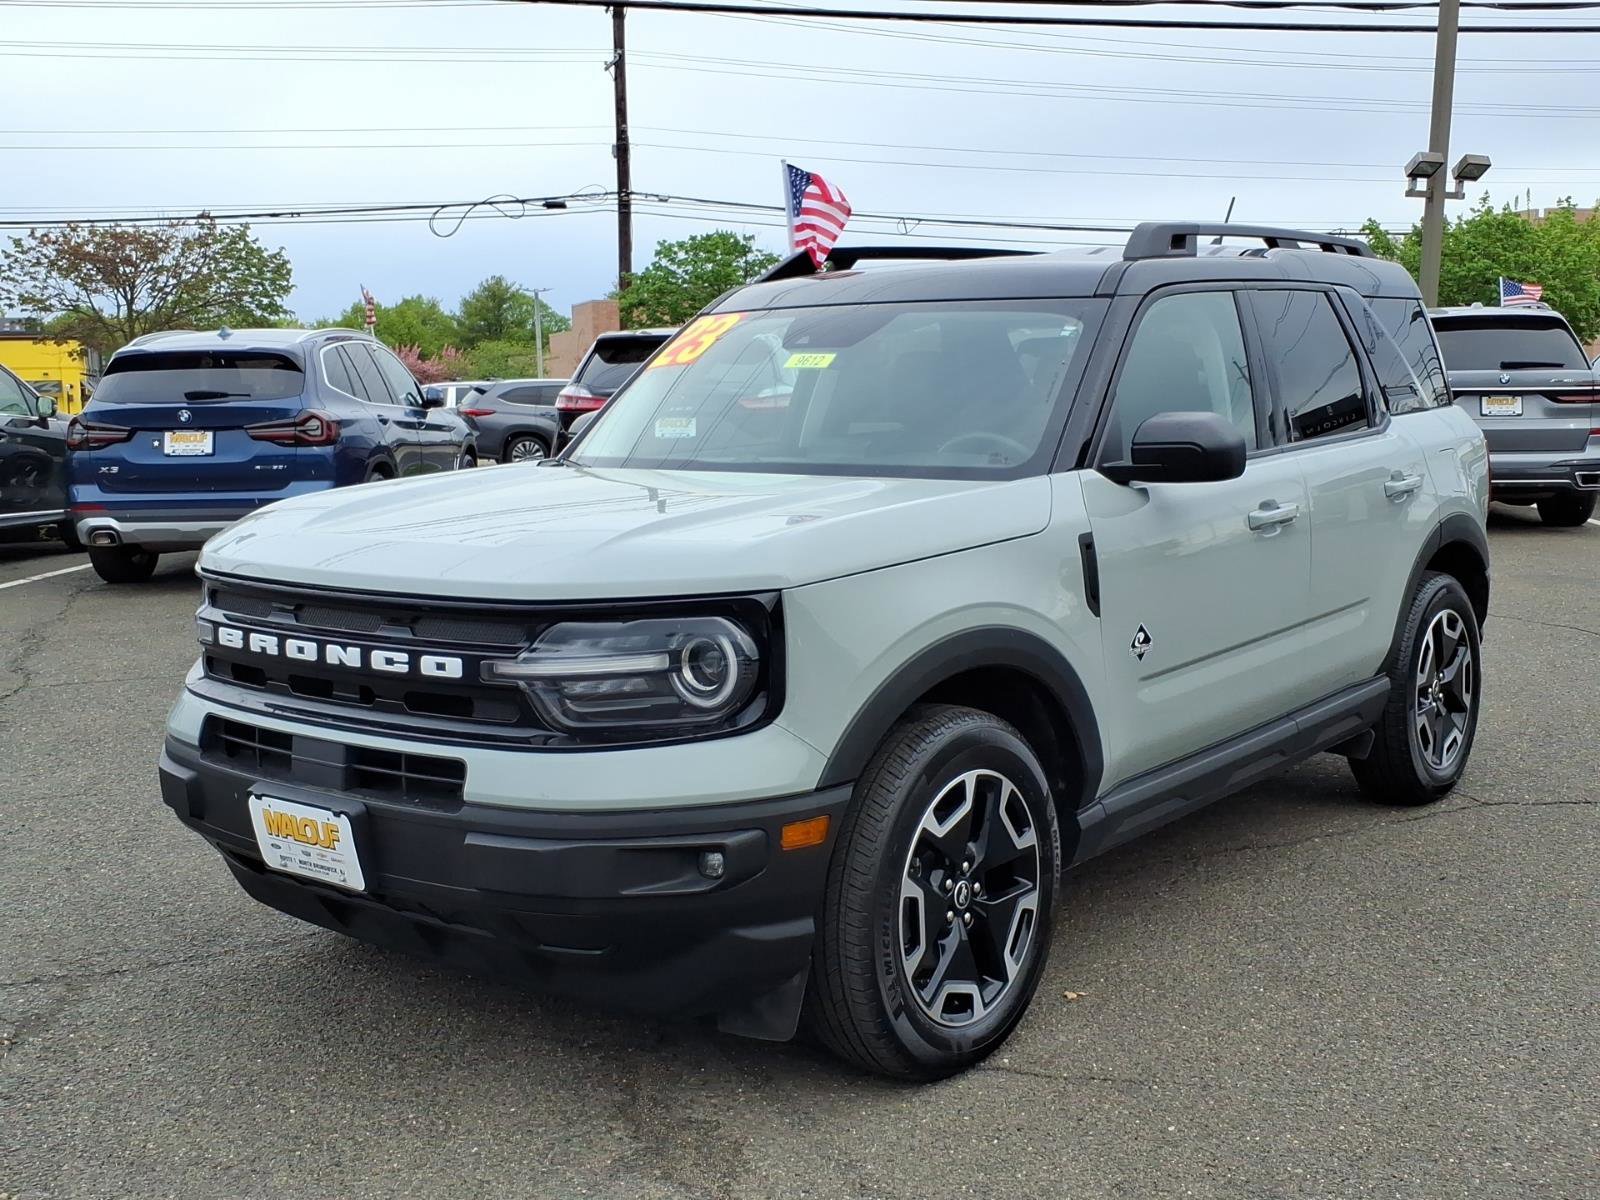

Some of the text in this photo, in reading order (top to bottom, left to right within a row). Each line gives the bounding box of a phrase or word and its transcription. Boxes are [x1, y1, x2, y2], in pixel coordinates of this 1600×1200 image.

[648, 313, 741, 369] 23
[794, 355, 826, 366] 9612
[97, 465, 119, 474] X3
[217, 627, 464, 678] BRONCO
[262, 808, 340, 850] MALOUF
